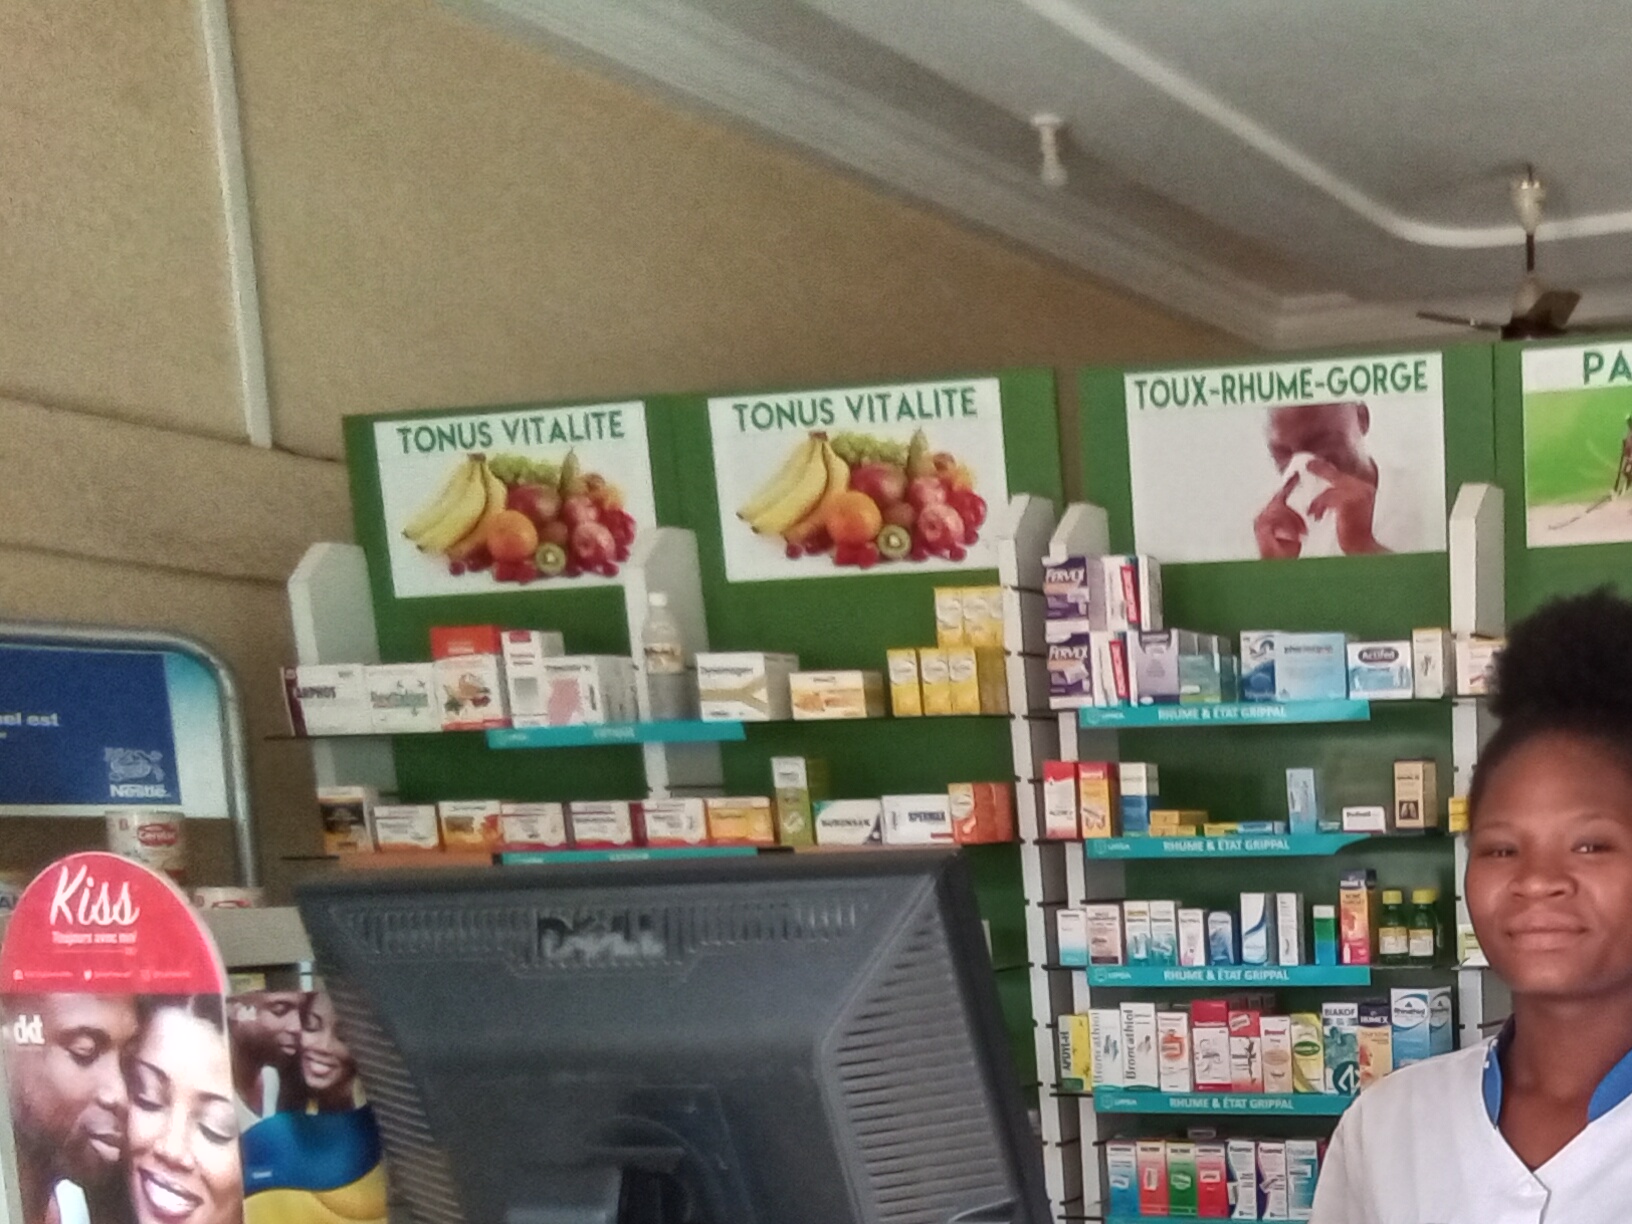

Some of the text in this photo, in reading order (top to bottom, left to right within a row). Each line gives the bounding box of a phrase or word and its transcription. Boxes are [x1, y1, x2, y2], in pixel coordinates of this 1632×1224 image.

[1134, 360, 1428, 409] TOUX-RHUME-GORGE
[734, 387, 978, 431] TONUS VITALITE
[397, 410, 625, 455] TONUS VITALITE
[1158, 707, 1197, 721] RHUME
[1241, 705, 1287, 719] GRIPPAL
[1164, 839, 1202, 851] RHUME
[1243, 838, 1290, 851] GRIPPAL
[50, 864, 140, 925] Kiss
[1164, 970, 1204, 981] RHUME
[1244, 969, 1289, 981] GRIPPAL
[1169, 1098, 1209, 1109] RHUME
[1212, 1098, 1221, 1109] &
[1223, 1095, 1247, 1109] ÉTAT
[1250, 1098, 1294, 1110] GRIPPAL
